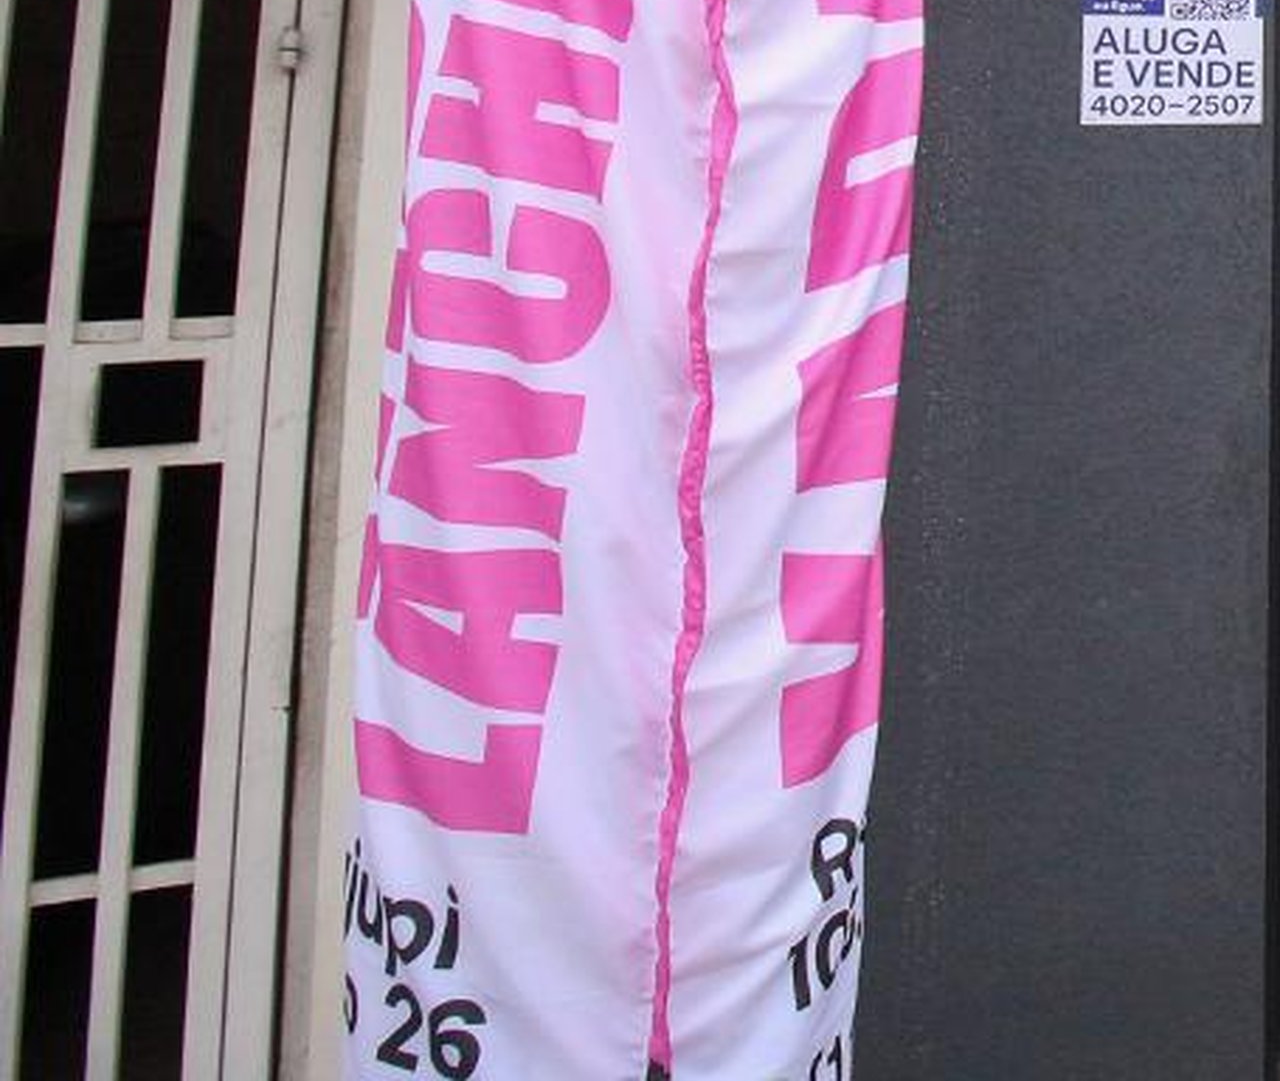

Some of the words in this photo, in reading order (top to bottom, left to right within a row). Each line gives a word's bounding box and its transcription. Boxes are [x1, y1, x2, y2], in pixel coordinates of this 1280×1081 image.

[1093, 27, 1227, 55] ALUGA
[1094, 60, 1114, 88] E
[1126, 60, 1256, 89] VENDE
[1090, 94, 1255, 117] 4020-2507
[376, 983, 488, 1081] 26
